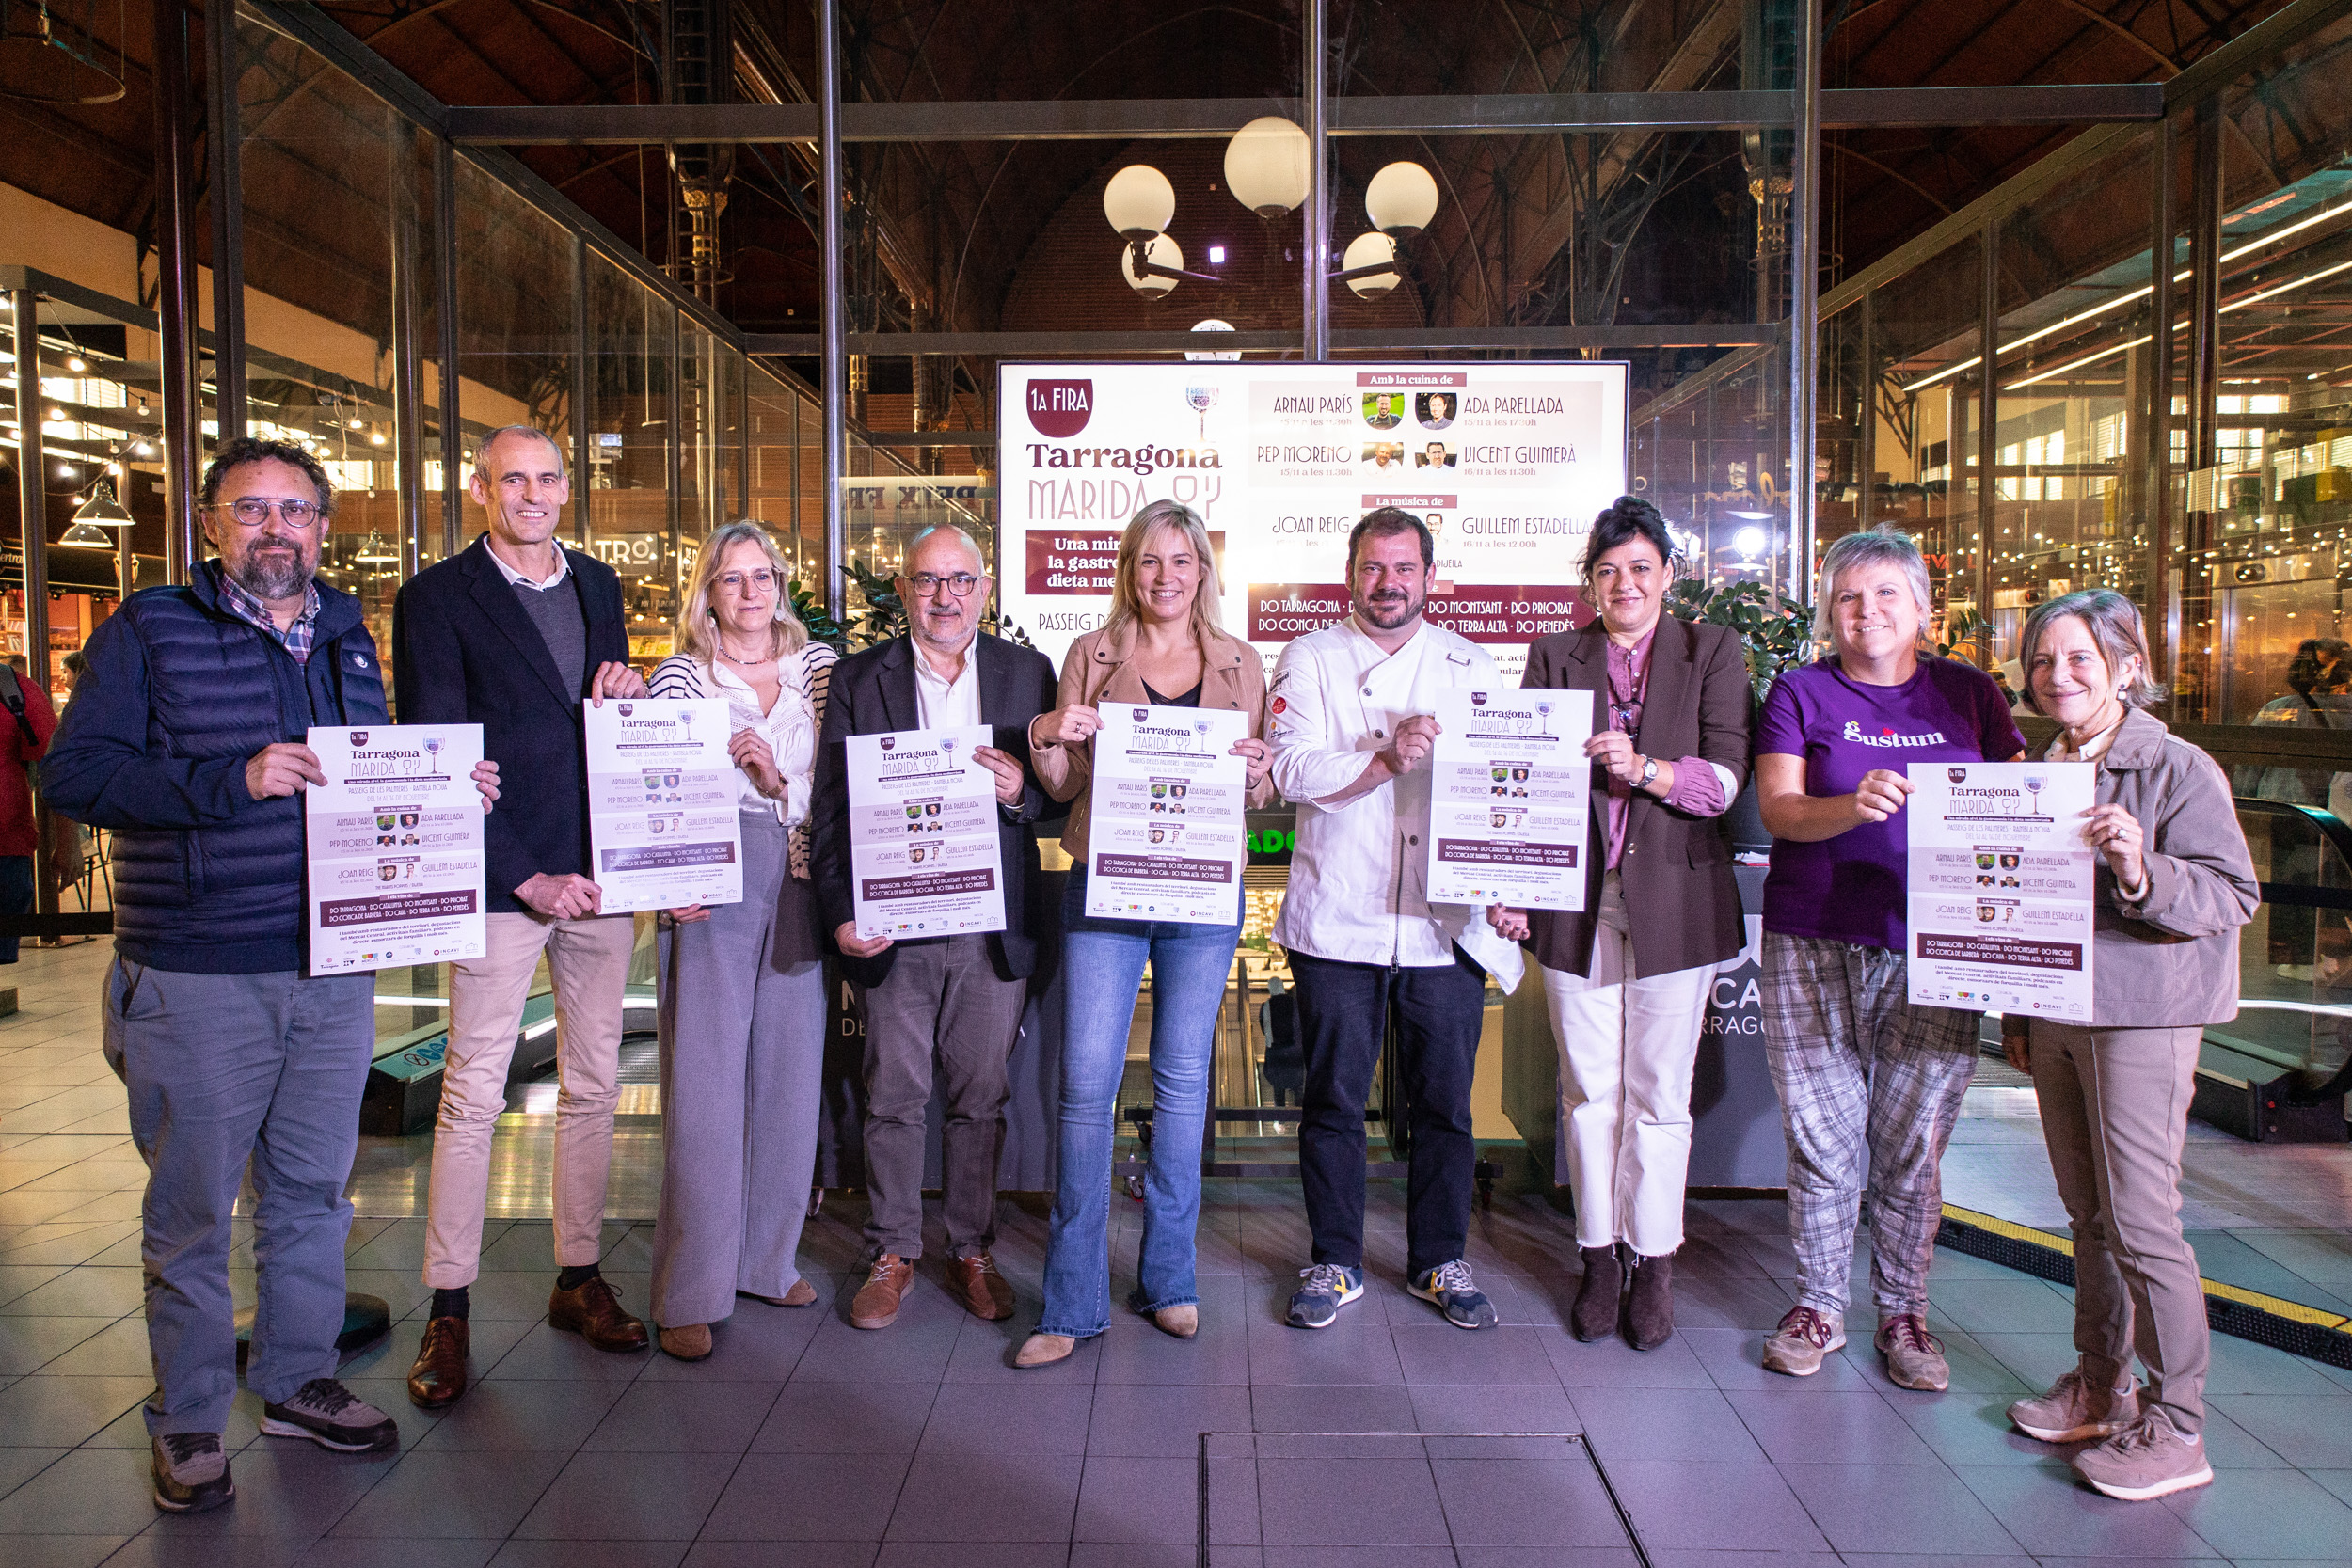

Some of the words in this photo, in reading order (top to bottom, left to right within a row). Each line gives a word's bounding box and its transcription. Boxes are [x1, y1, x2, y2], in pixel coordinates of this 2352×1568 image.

[1370, 375, 1393, 384] Amb
[1396, 375, 1406, 384] la
[1408, 375, 1438, 384] cuina
[1440, 375, 1453, 384] de
[1053, 388, 1089, 411] FIRA
[1274, 397, 1314, 414] ARNAU
[1320, 394, 1352, 414] PARÍS
[1464, 397, 1490, 413] ADA
[1495, 397, 1564, 413] PARELLADA
[1026, 444, 1222, 475] Tarragona
[1258, 446, 1279, 462] PEP
[1284, 446, 1351, 462] MORENO
[1465, 447, 1511, 463] VICENT
[1515, 444, 1576, 463] GUIMERÀ
[1280, 468, 1300, 477] 15/11
[1029, 478, 1150, 519] MARIDA
[1376, 498, 1389, 506] La
[1391, 498, 1429, 506] música
[1431, 498, 1443, 506] de
[1273, 516, 1313, 533] JOAN
[1319, 517, 1349, 533] REIG
[1462, 517, 1520, 534] GUILLEM
[1525, 517, 1590, 534] ESTADELLA
[1055, 538, 1089, 550] Una
[1092, 536, 1120, 550] mir
[1048, 555, 1065, 569] la
[1047, 573, 1089, 587] dieta
[1261, 600, 1279, 612] DO
[1281, 600, 1340, 612] TARRAGONA
[1429, 601, 1447, 613] DO
[1450, 601, 1502, 614] MONTSANT
[1511, 602, 1530, 614] DO
[1532, 602, 1573, 614] PRIORAT
[1040, 613, 1090, 630] PASSEIG
[1259, 619, 1277, 631] DO
[1279, 619, 1319, 631] CONCA
[1438, 620, 1455, 631] DO
[1458, 620, 1485, 632] TERRA
[1486, 620, 1508, 632] ALTA
[1517, 620, 1534, 633] DO
[1537, 619, 1574, 633] PENEDÈS
[1471, 709, 1532, 720] Tarragona
[619, 720, 676, 729] Tarragona
[1132, 726, 1191, 737] Tarragona
[1471, 720, 1510, 733] MARIDA
[621, 730, 658, 743] MARIDA
[1844, 721, 1947, 747] gustum
[1132, 736, 1169, 750] MARIDA
[351, 749, 420, 761] Tarragona
[882, 750, 938, 762] Tarragona
[351, 761, 395, 777] MARIDA
[882, 760, 919, 775] MARIDA
[1949, 787, 2020, 799] Tarragona
[1950, 800, 1994, 814] MARIDA
[435, 813, 463, 821] PARELLADA
[329, 840, 342, 848] PEP
[2037, 858, 2069, 866] PARELLADA
[358, 868, 373, 877] REIG
[1957, 906, 1971, 914] REIG
[1711, 978, 1760, 1008] CA
